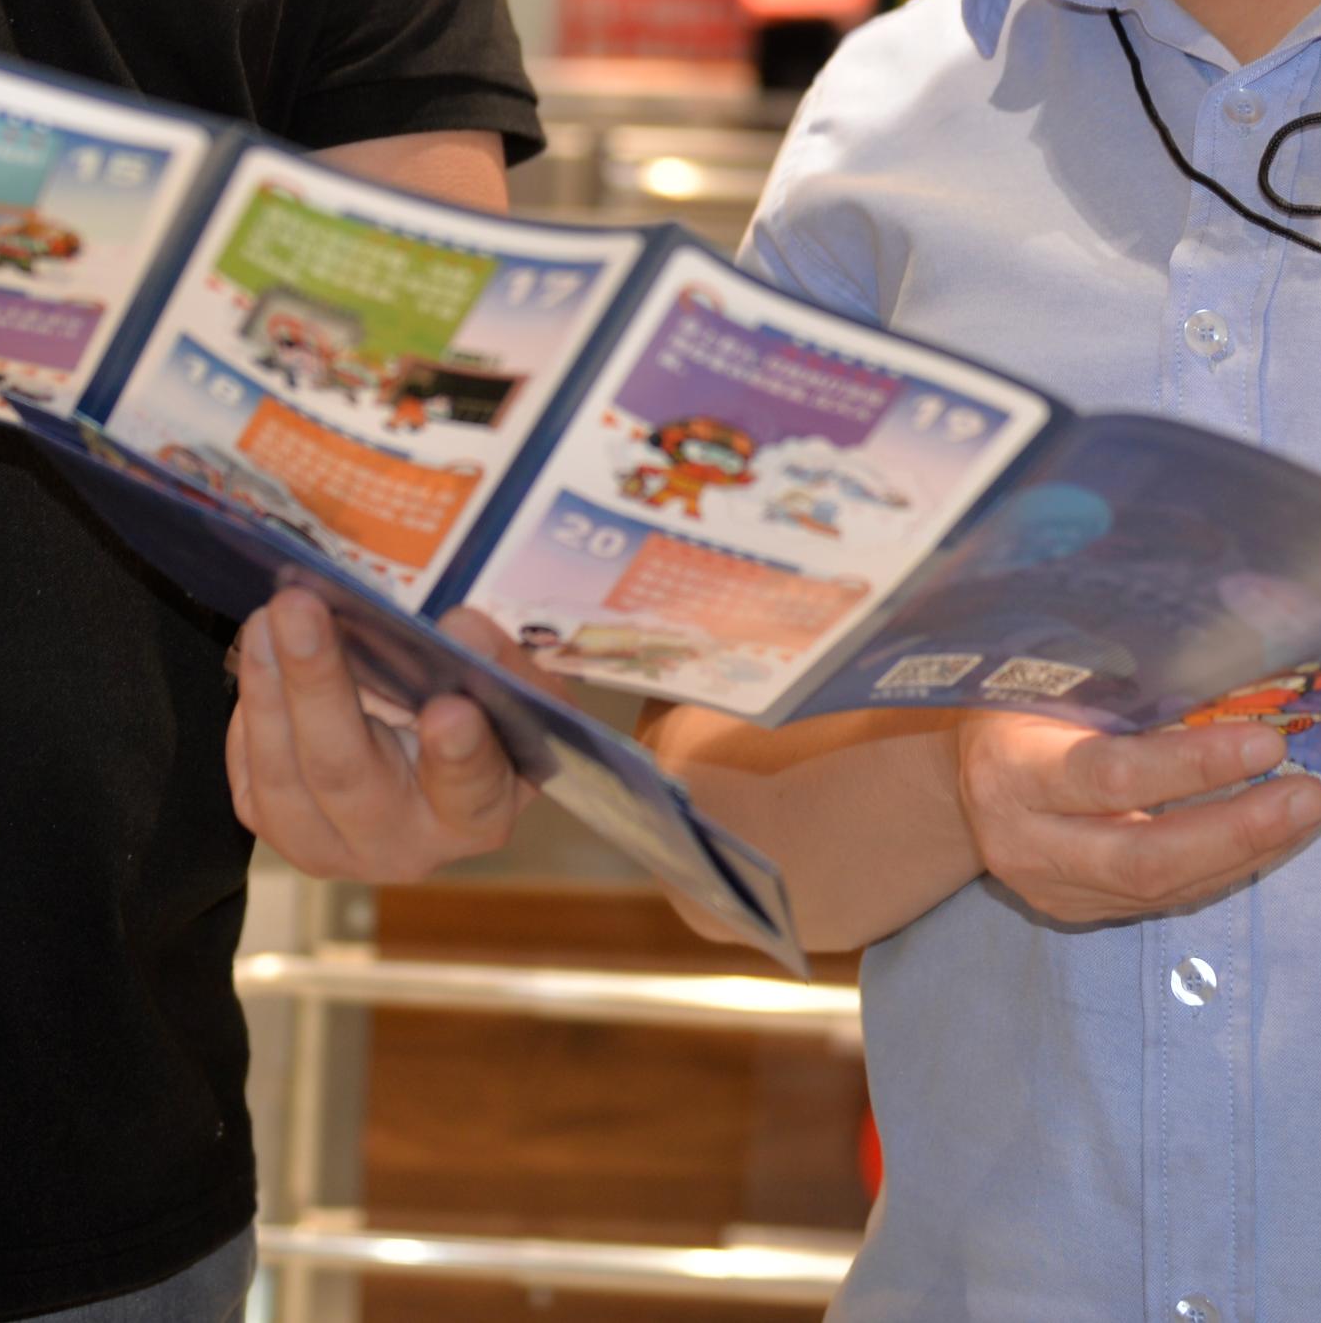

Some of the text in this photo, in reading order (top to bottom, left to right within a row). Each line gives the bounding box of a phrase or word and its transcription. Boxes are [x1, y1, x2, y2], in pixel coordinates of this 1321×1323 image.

[506, 272, 581, 310] 17
[909, 392, 987, 443] 19
[552, 514, 627, 559] 20
